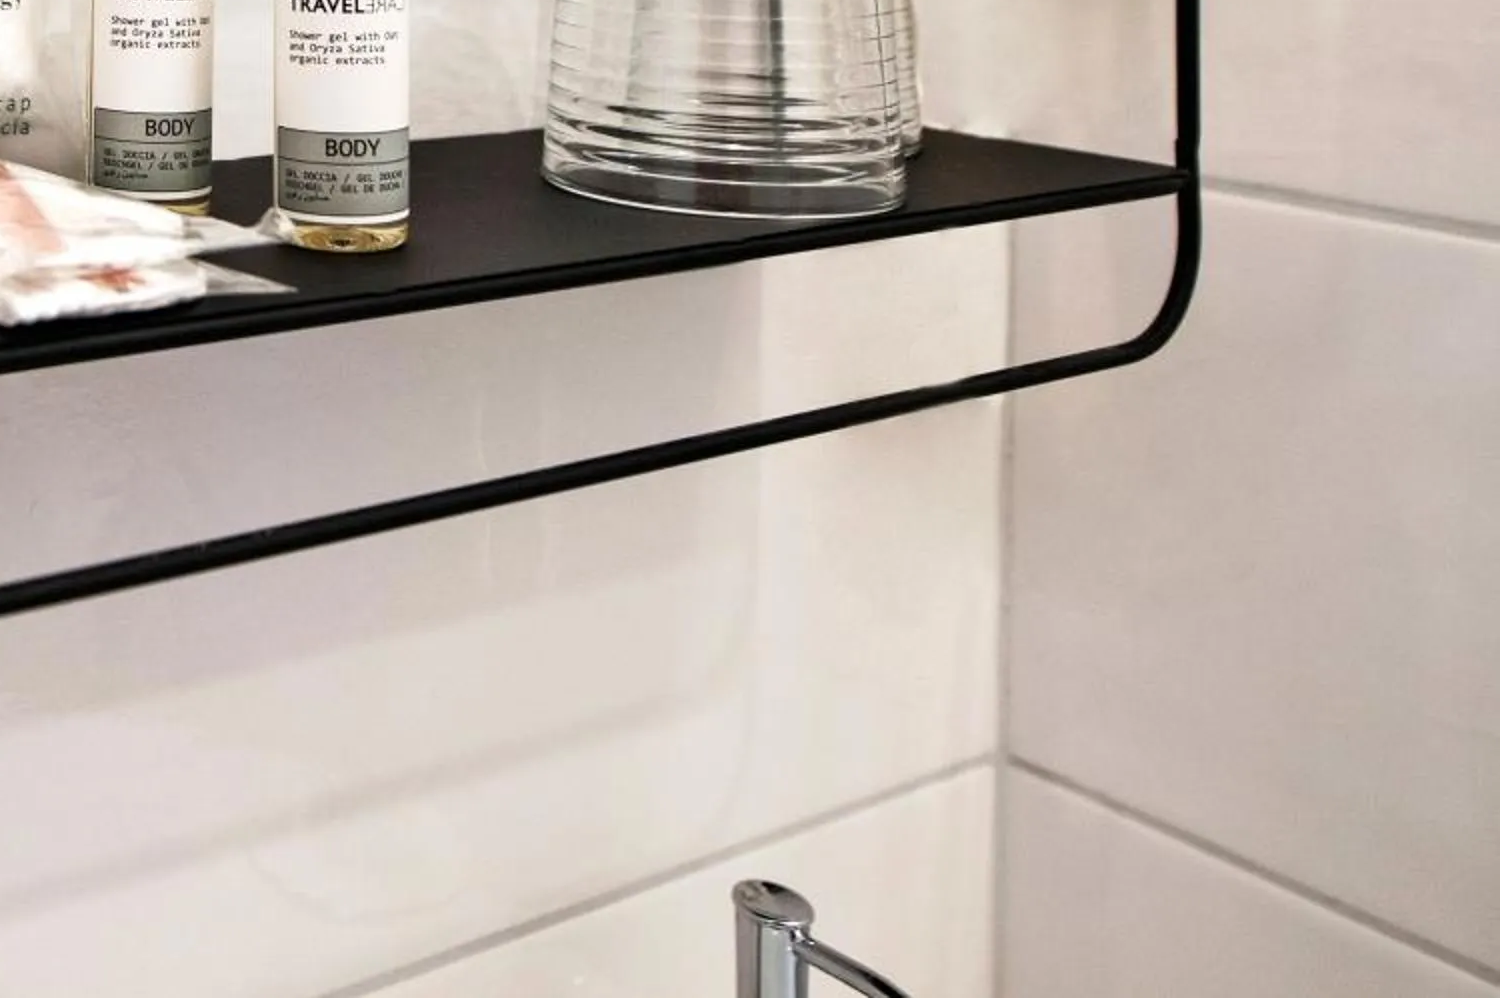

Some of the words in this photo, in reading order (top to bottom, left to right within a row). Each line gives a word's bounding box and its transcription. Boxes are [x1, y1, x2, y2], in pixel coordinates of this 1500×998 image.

[111, 16, 144, 26] Shower
[151, 18, 169, 28] gel
[175, 18, 196, 27] with
[289, 29, 323, 40] Shower
[329, 31, 348, 43] gel
[355, 31, 380, 41] with
[110, 38, 150, 49] organic
[157, 39, 201, 49] extracts
[309, 43, 343, 54] Oryza
[349, 43, 385, 53] Sativa
[289, 54, 329, 65] organic
[335, 55, 385, 65] extracts
[145, 118, 195, 137] BODY
[325, 138, 381, 157] BODY
